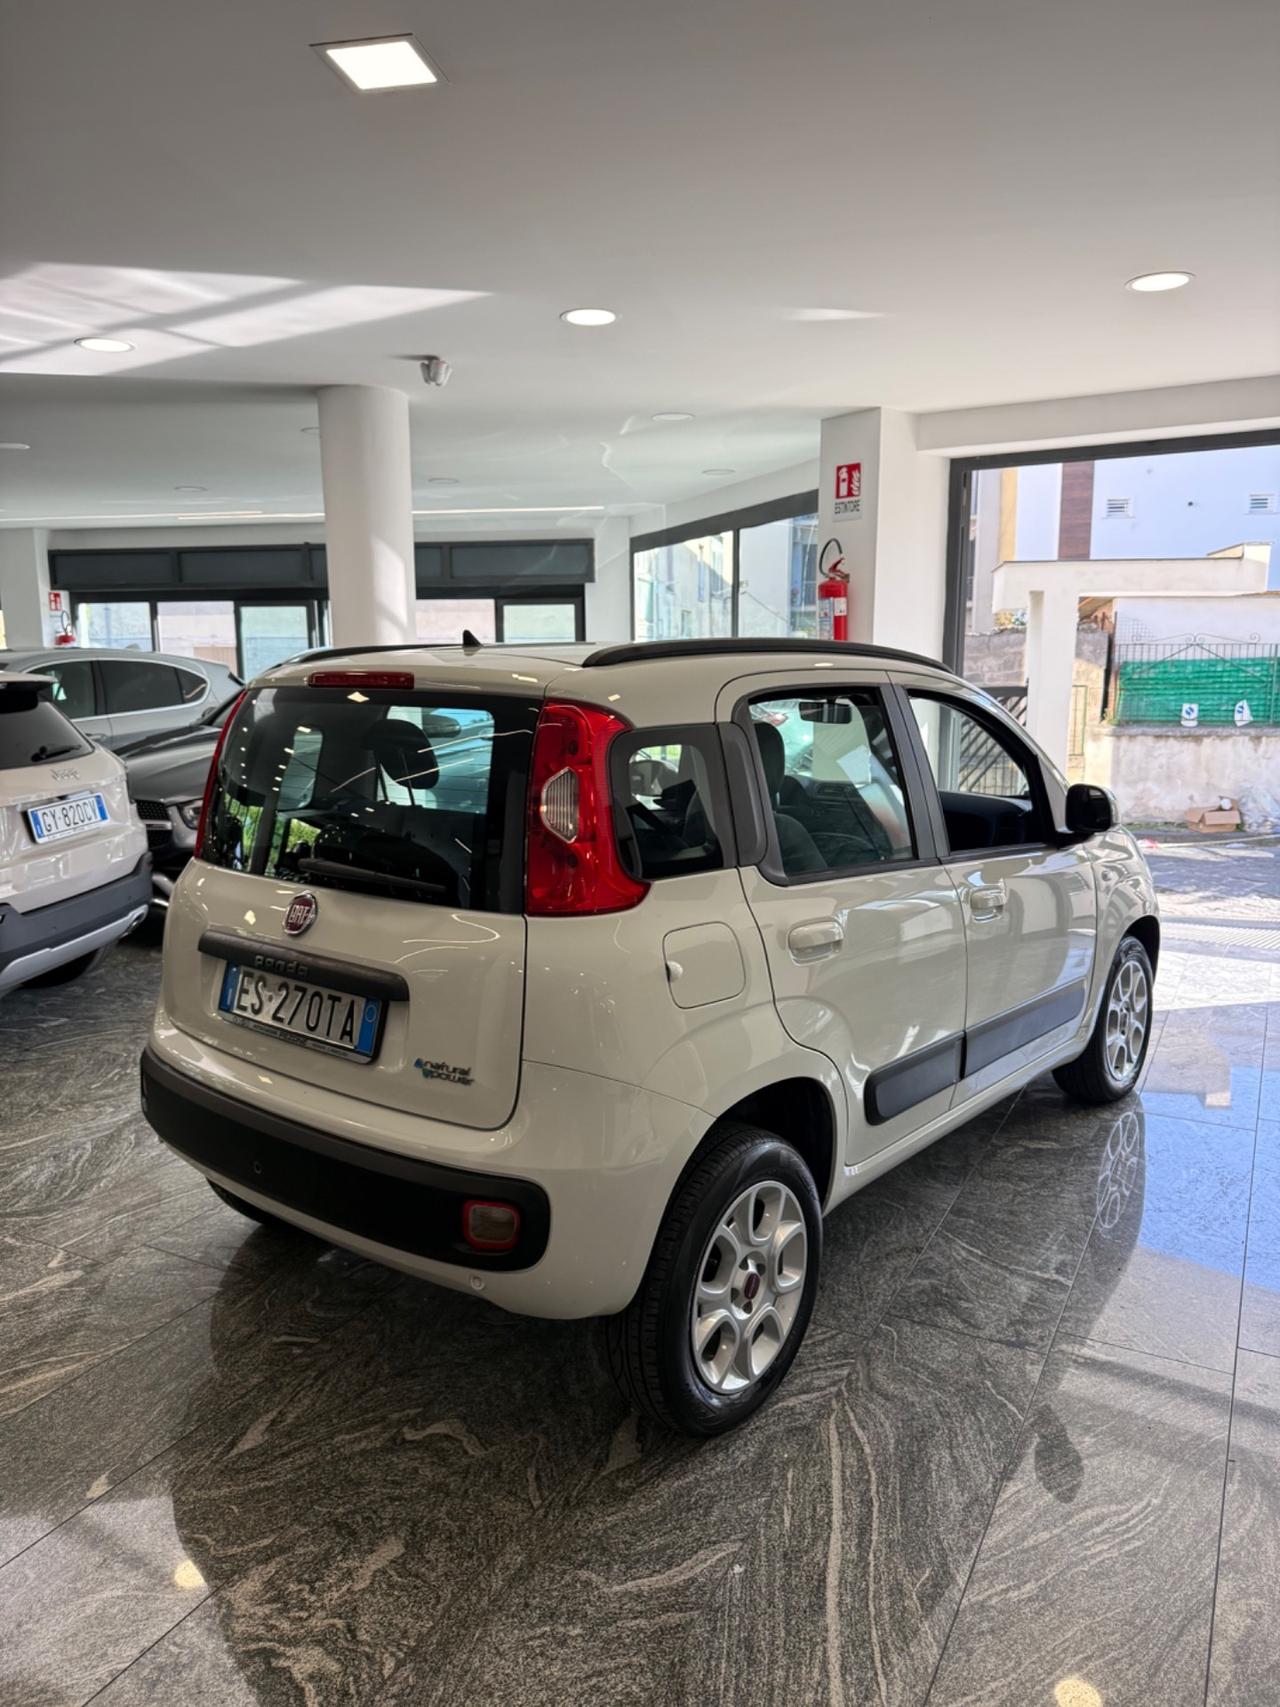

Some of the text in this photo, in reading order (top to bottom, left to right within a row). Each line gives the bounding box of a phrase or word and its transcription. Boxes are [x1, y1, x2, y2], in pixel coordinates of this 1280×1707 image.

[236, 970, 267, 1015] ES
[271, 981, 356, 1043] 270TA
[423, 1060, 472, 1076] natural
[430, 1070, 475, 1087] power
